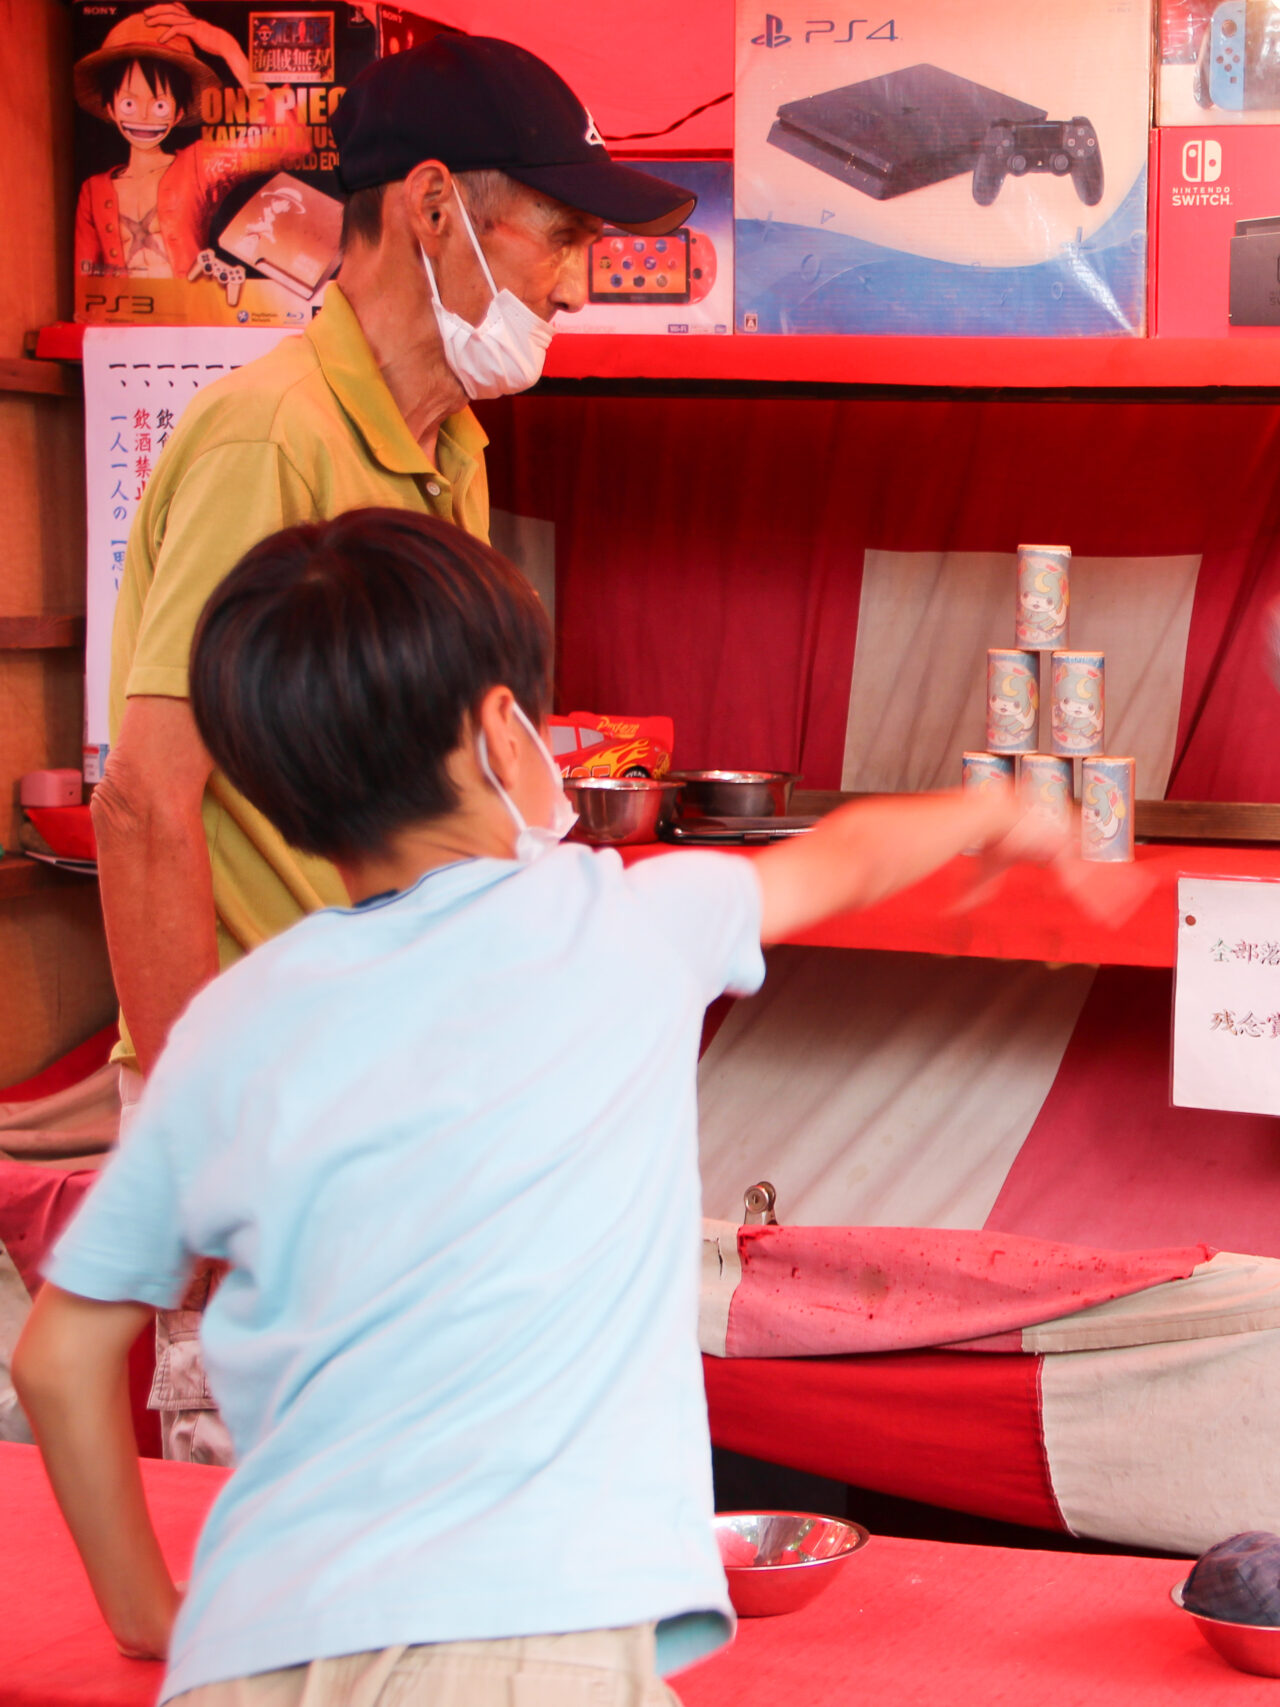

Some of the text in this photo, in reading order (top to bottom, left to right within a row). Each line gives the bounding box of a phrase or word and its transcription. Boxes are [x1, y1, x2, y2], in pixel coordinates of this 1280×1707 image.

[83, 7, 117, 15] SONY
[805, 19, 899, 43] PS4
[200, 87, 347, 125] ONE PIEC
[1172, 195, 1231, 206] SWITCH
[85, 294, 154, 314] PS3
